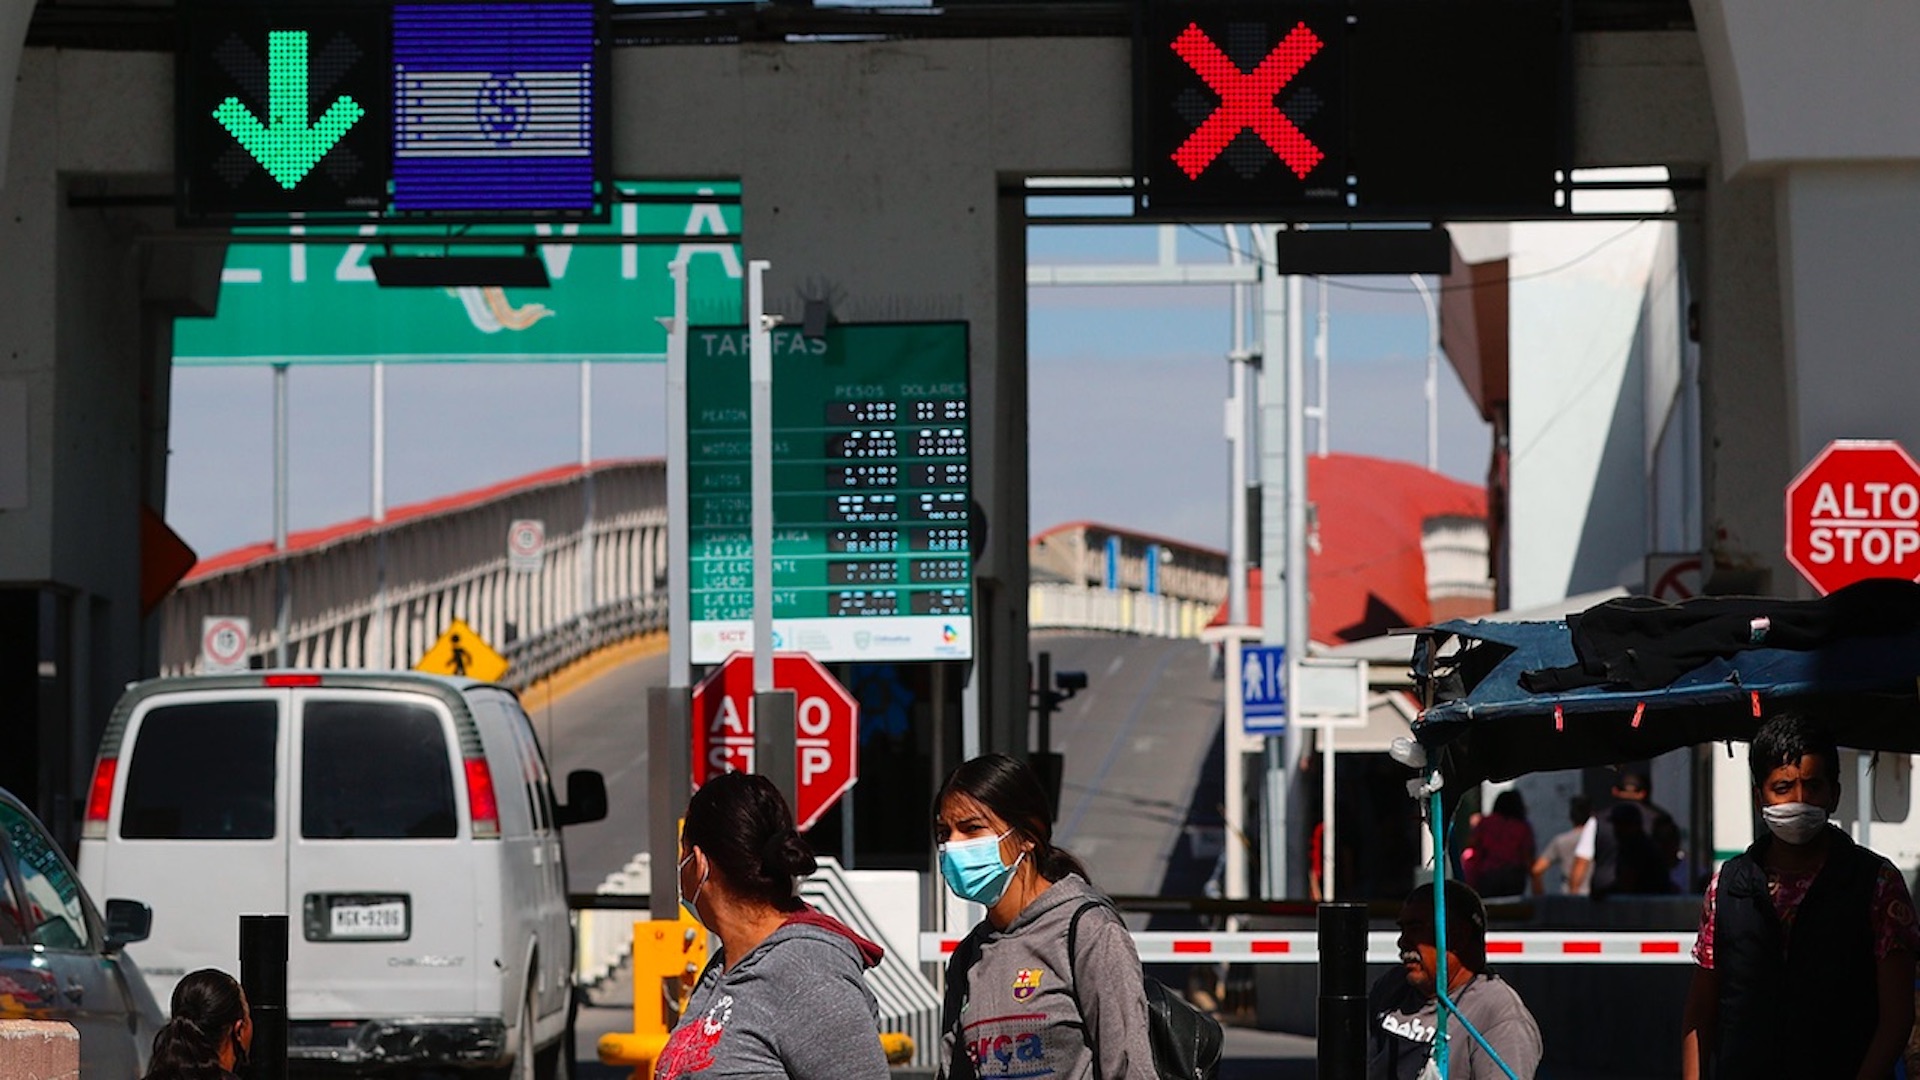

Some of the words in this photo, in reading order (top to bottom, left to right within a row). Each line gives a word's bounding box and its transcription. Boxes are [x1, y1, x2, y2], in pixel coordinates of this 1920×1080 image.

[701, 332, 827, 356] TARFAS
[835, 385, 884, 396] PESOS
[901, 384, 967, 396] DOLARES
[1810, 481, 1920, 519] ALTO
[1809, 528, 1920, 565] STOP
[729, 560, 796, 574] EXCNTE
[729, 592, 796, 606] EXCNTE
[718, 630, 746, 641] SCT
